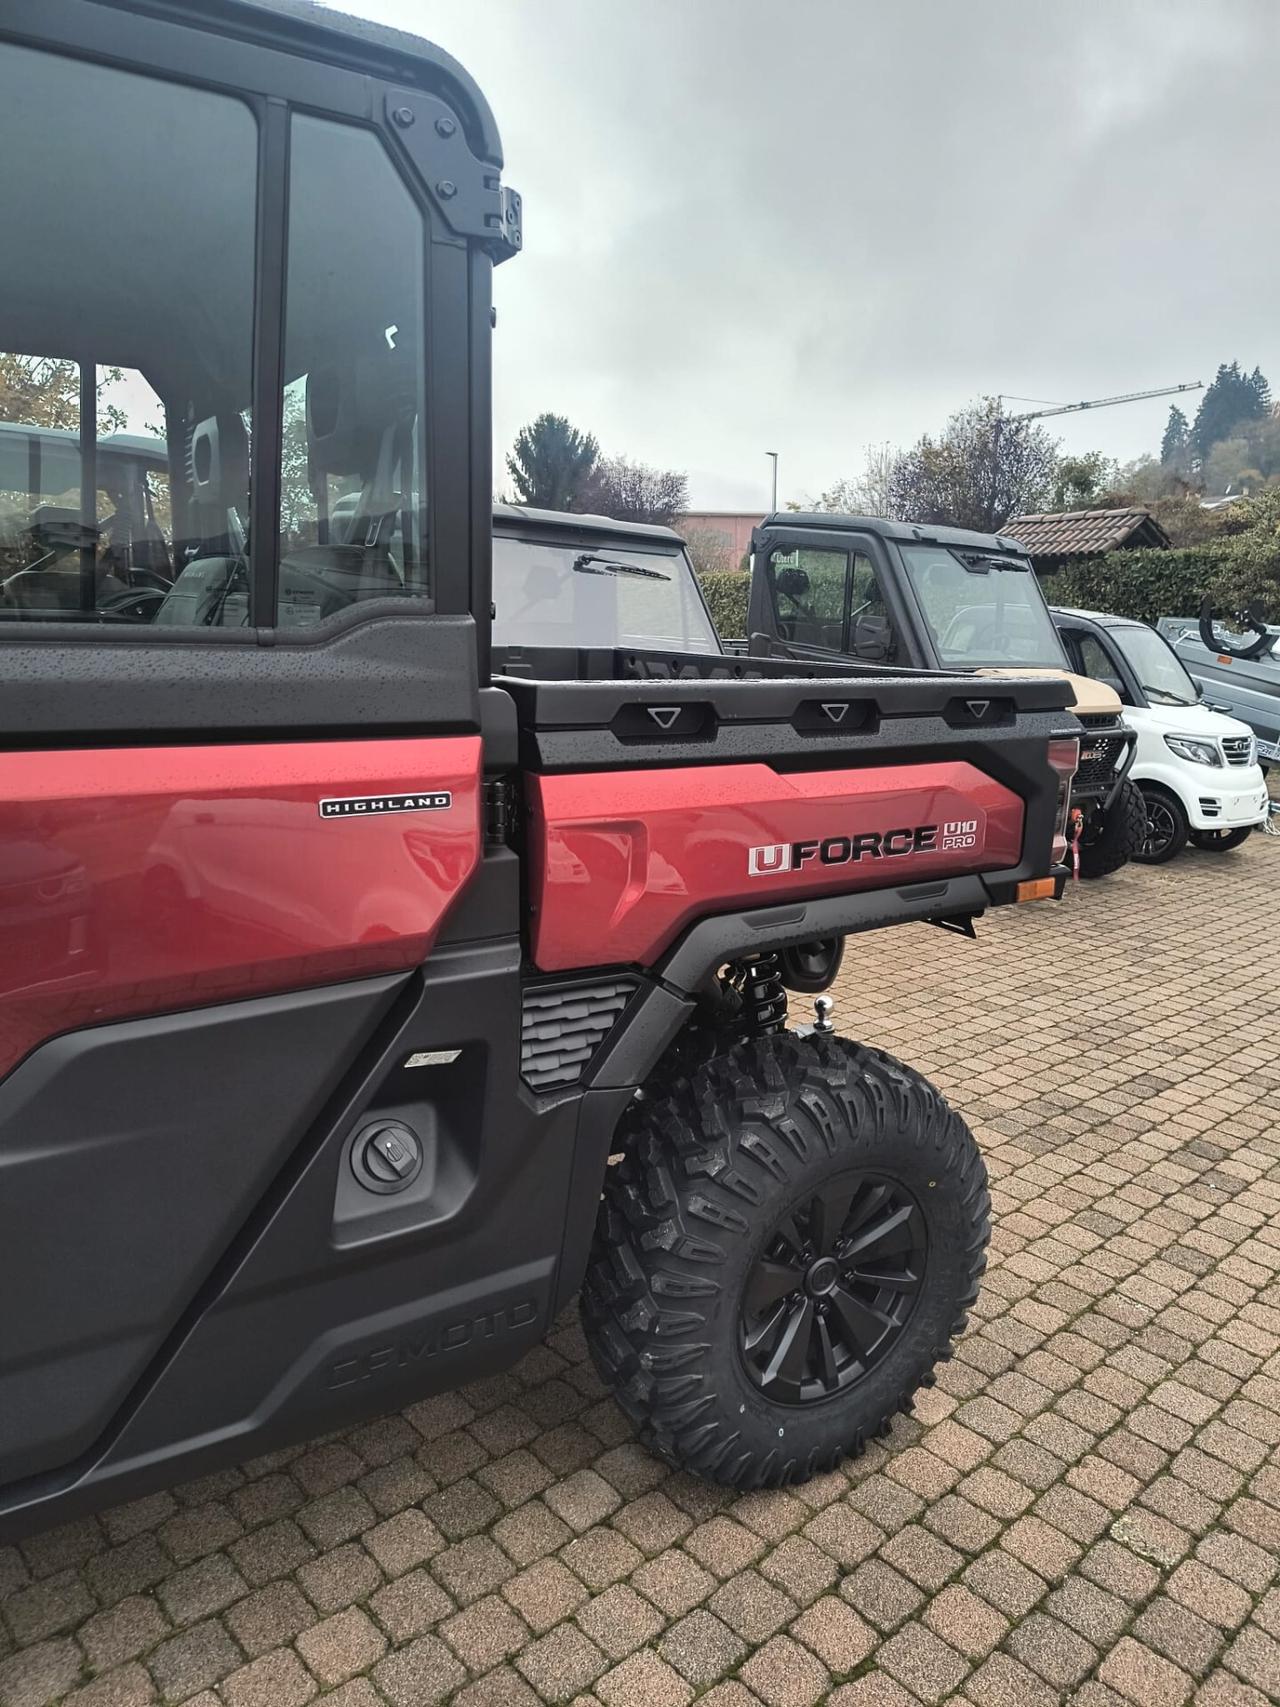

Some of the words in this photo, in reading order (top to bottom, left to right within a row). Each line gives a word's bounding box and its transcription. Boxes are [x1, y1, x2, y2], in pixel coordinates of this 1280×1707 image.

[326, 796, 447, 813] HIGHLAND
[943, 820, 976, 835] U10
[942, 835, 976, 849] PRO
